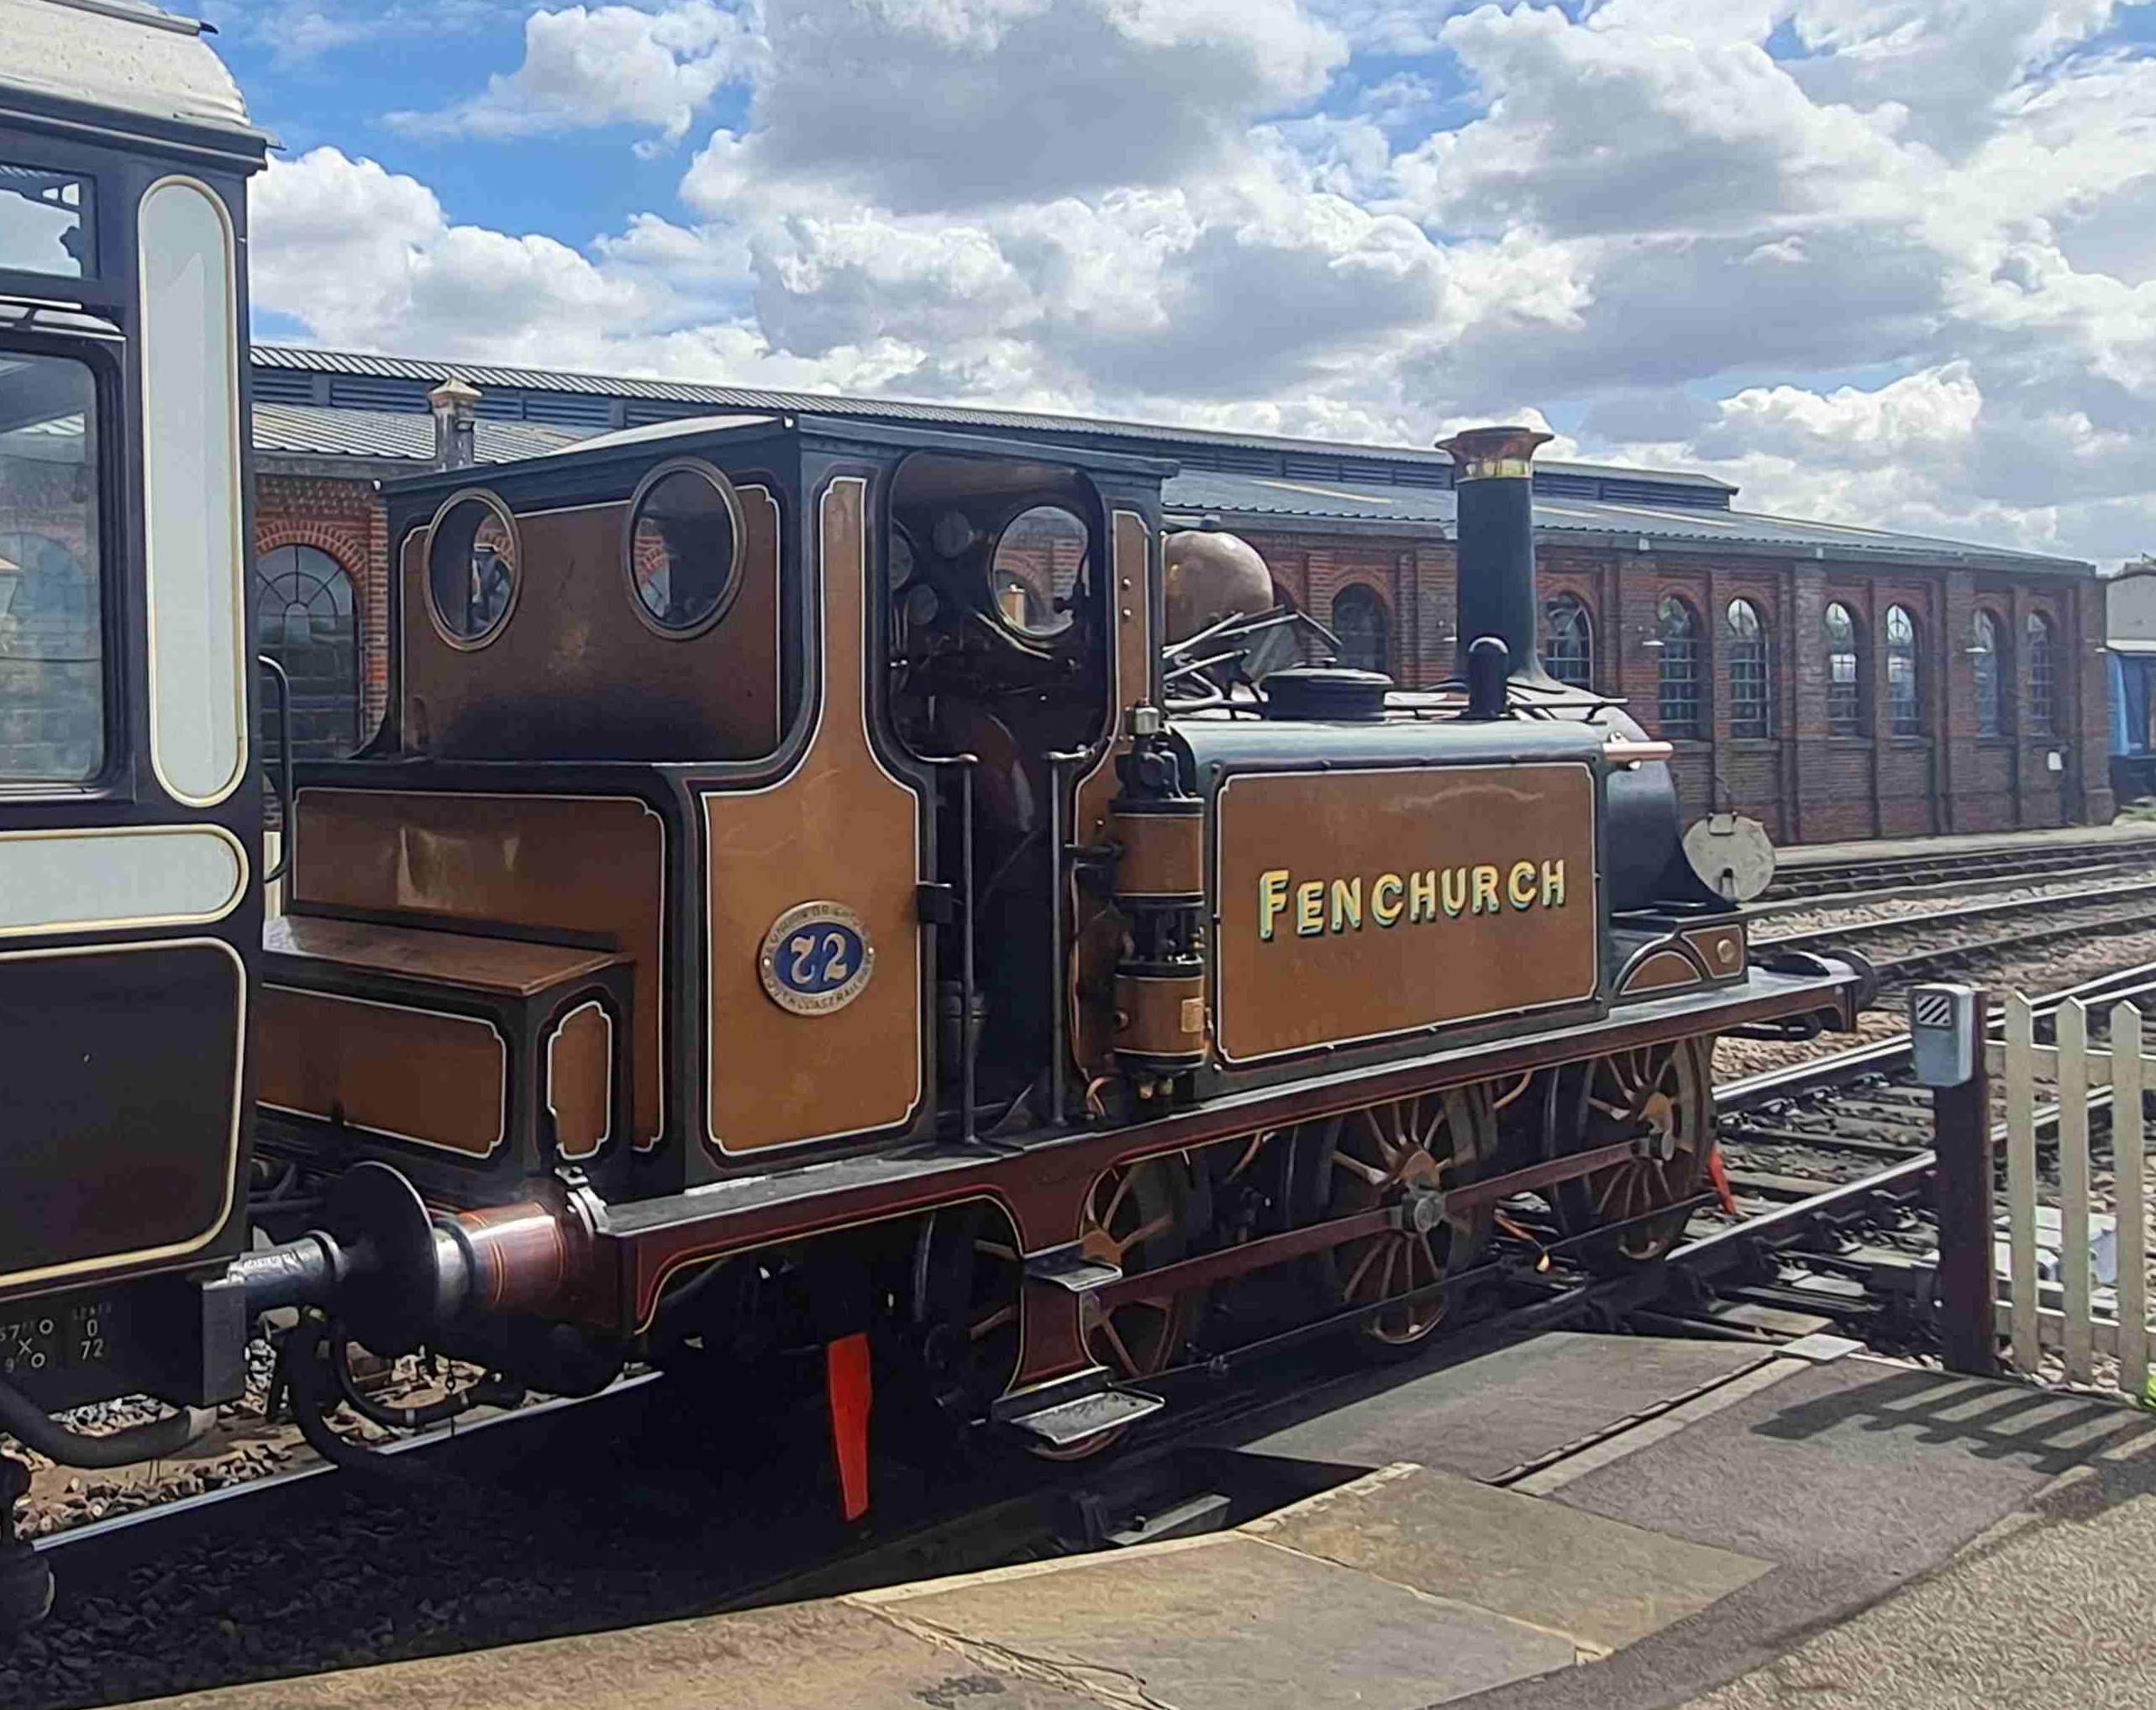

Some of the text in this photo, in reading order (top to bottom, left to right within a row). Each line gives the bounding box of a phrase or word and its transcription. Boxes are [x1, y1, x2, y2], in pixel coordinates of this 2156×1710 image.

[1259, 858, 1565, 942] FENCHURCH
[790, 931, 849, 986] 72
[80, 1337, 104, 1360] 72
